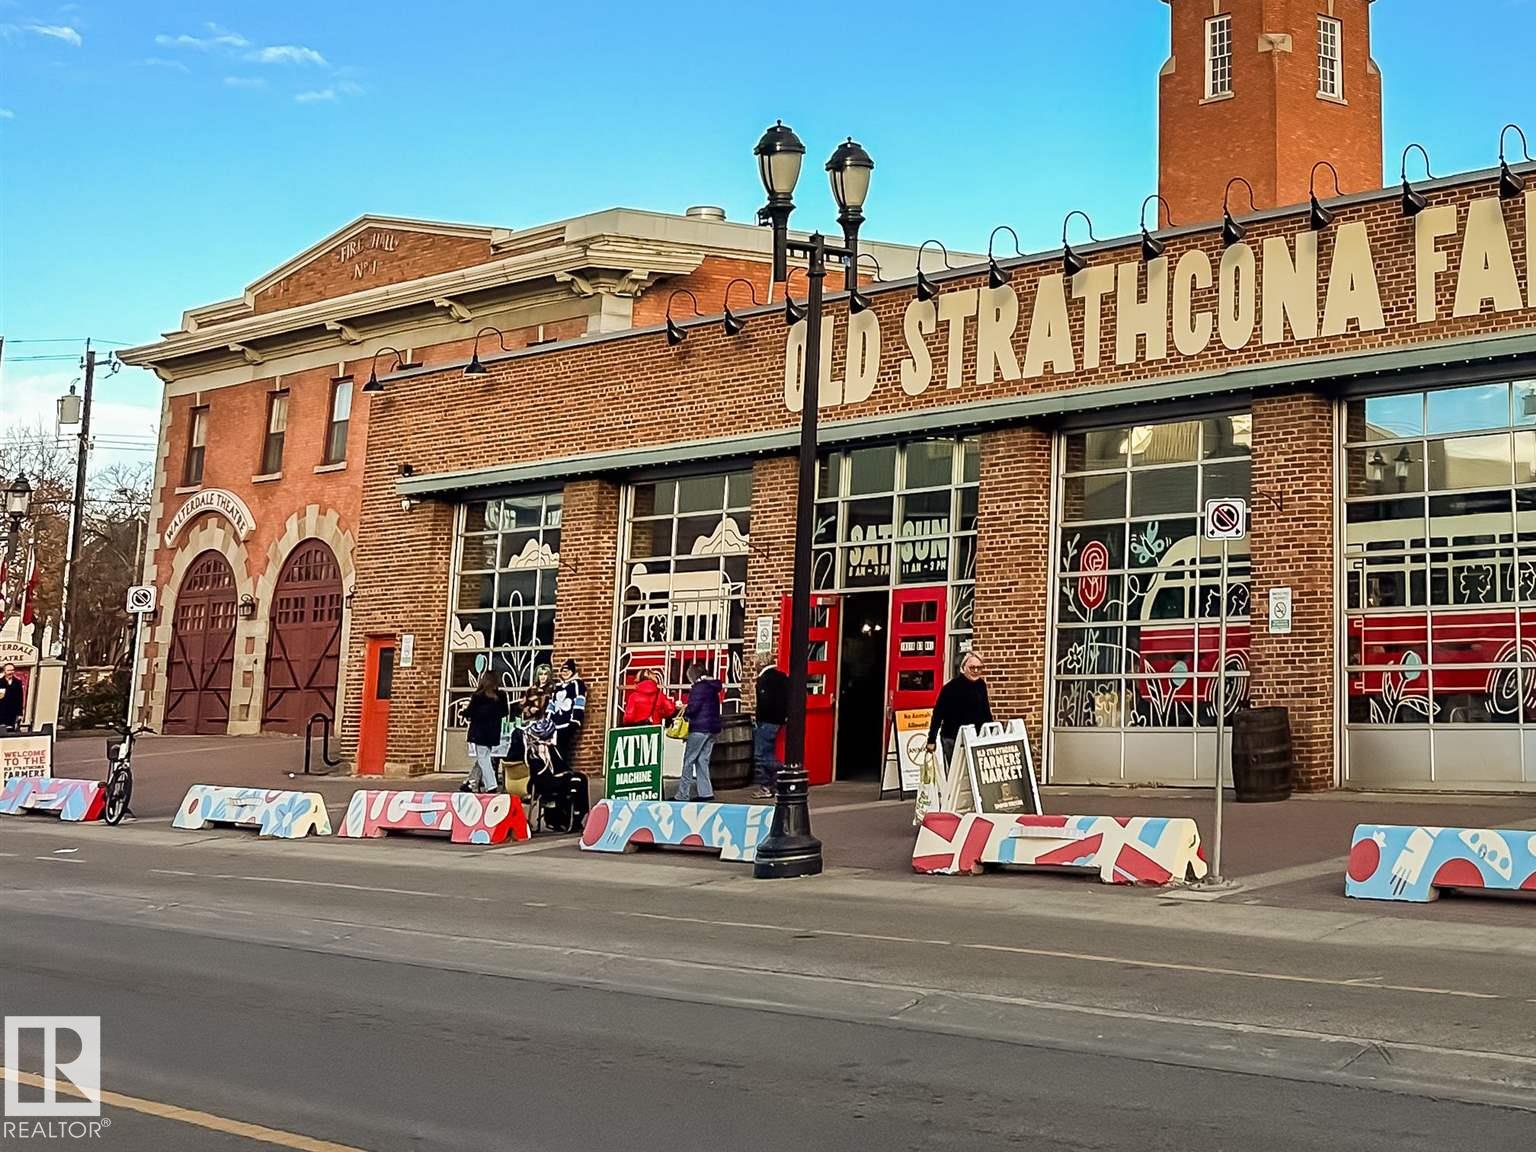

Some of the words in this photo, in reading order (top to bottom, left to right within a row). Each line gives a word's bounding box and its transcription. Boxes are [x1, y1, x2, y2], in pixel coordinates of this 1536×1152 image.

[785, 309, 881, 413] OLD
[900, 221, 1386, 397] STRATHCONA
[166, 493, 215, 540] WALTERDALE
[216, 494, 246, 534] THEATRE
[850, 524, 892, 566] SAT
[901, 518, 948, 562] SUN
[0, 643, 33, 655] ERDALE
[4, 758, 19, 766] TO
[610, 733, 659, 769] ATM
[616, 770, 652, 785] MACHINE
[981, 765, 1023, 785] MARKET
